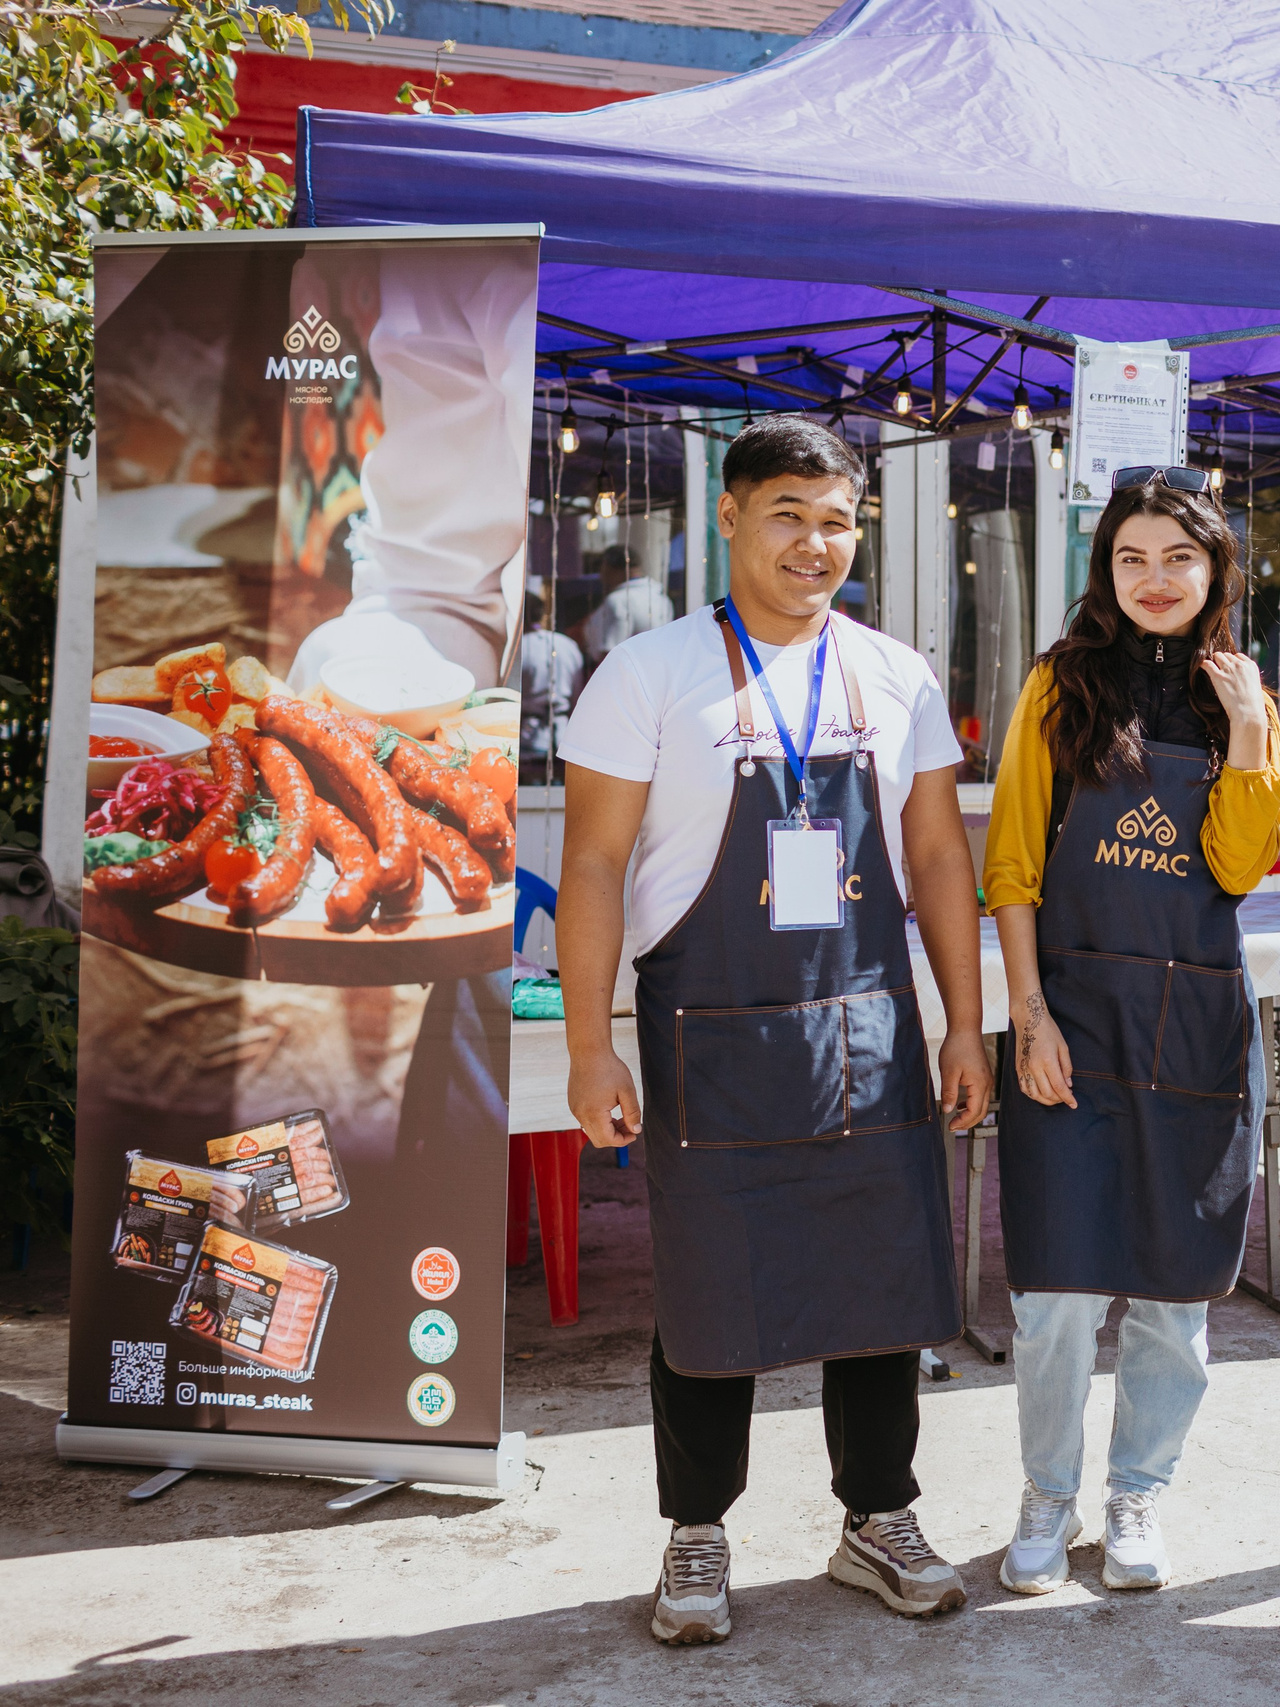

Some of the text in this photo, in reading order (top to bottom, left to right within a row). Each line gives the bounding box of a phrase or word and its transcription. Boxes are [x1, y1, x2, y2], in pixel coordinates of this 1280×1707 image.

[265, 354, 358, 380] МУРАС
[295, 386, 329, 394] мясное
[1090, 393, 1167, 407] СЕРТИФИКАТ
[289, 396, 333, 405] наследие
[1094, 839, 1190, 877] МУРАС
[178, 1360, 316, 1380] Больше информации:
[200, 1391, 314, 1411] muras_steak
